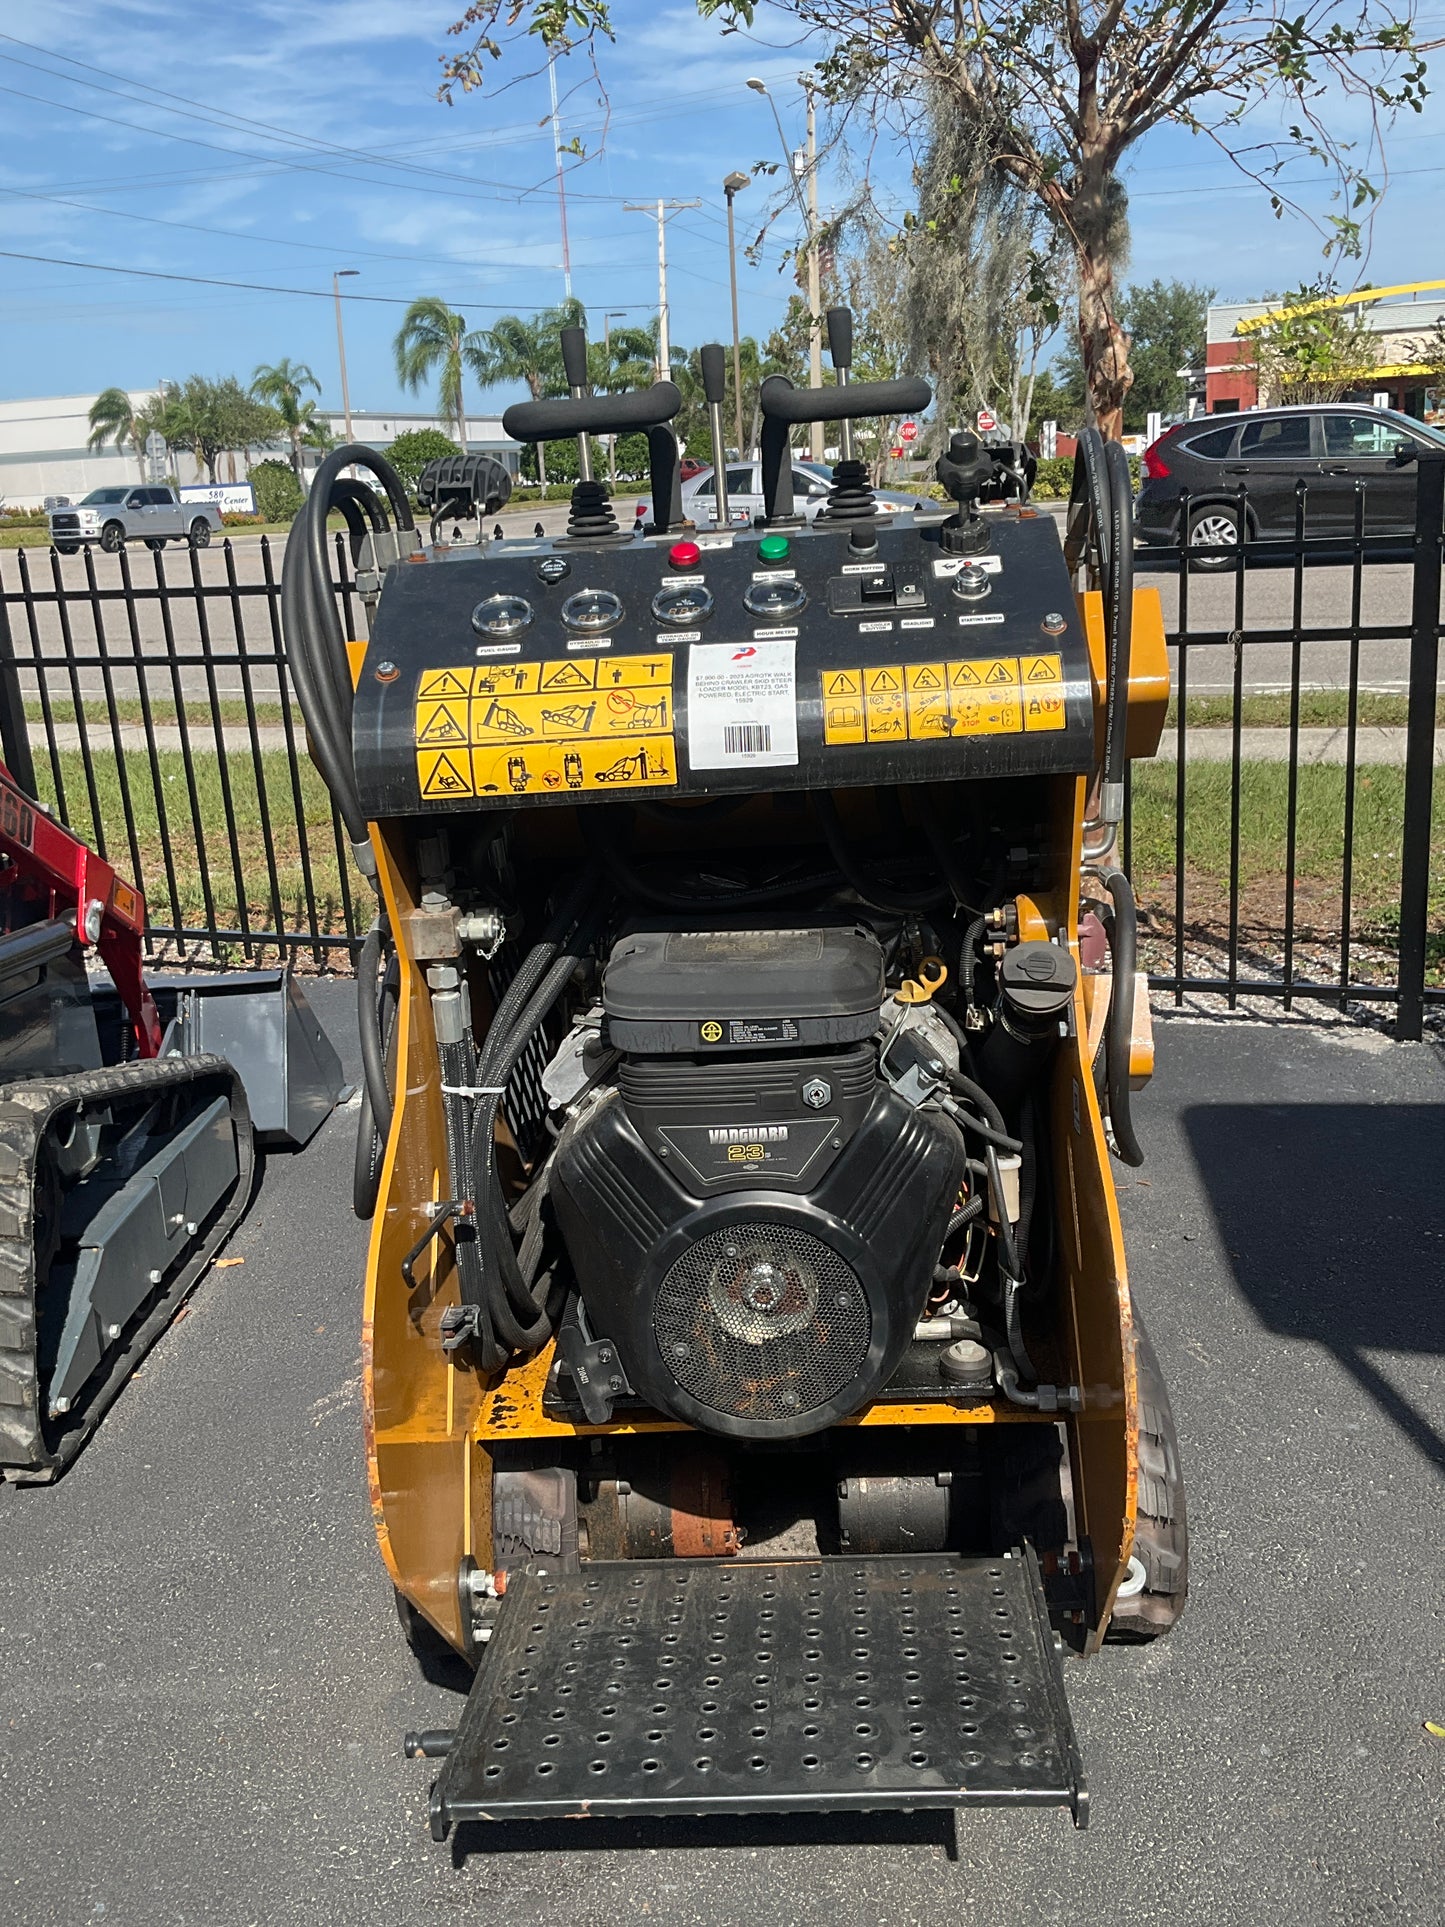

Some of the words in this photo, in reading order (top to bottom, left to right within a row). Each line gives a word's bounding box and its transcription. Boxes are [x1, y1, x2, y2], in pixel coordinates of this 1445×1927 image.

[902, 427, 916, 436] STOP
[208, 490, 224, 500] 580
[224, 496, 248, 505] Center
[0, 785, 33, 848] 60
[708, 1125, 789, 1144] VANGUARD
[727, 1143, 765, 1161] 23
